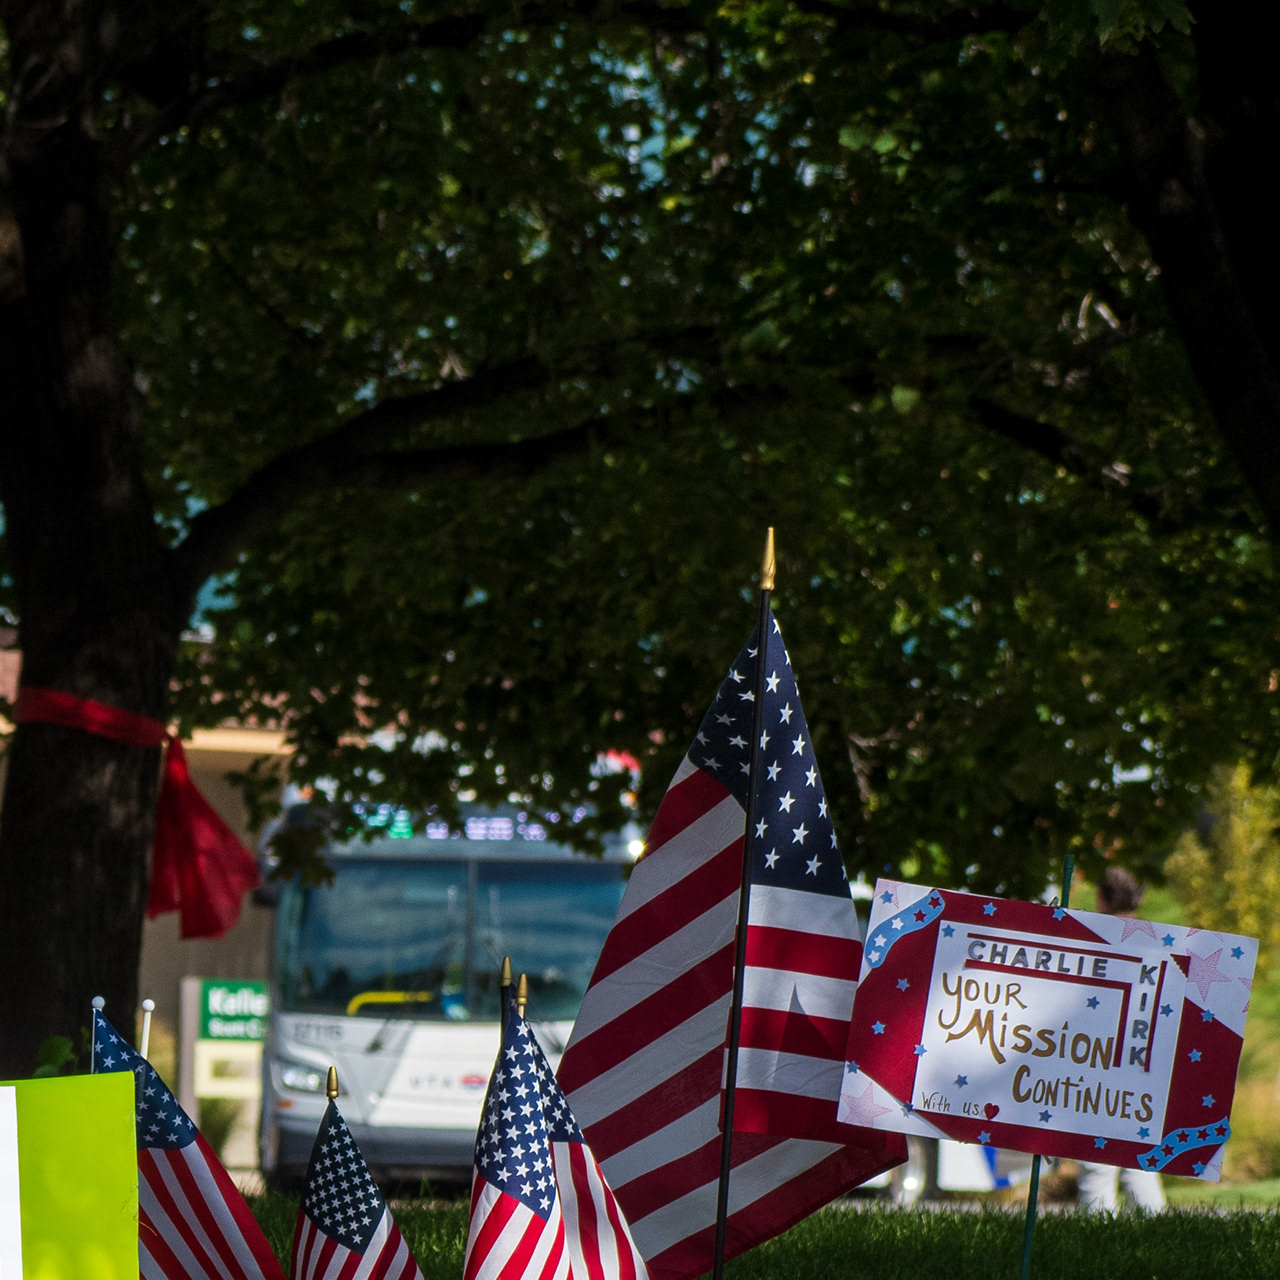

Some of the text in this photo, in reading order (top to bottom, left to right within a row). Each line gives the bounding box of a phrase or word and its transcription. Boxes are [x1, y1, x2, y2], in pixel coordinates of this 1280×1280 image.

[966, 940, 1109, 978] CHARLIE
[1128, 962, 1159, 1068] KIRK
[962, 1101, 981, 1118] us
